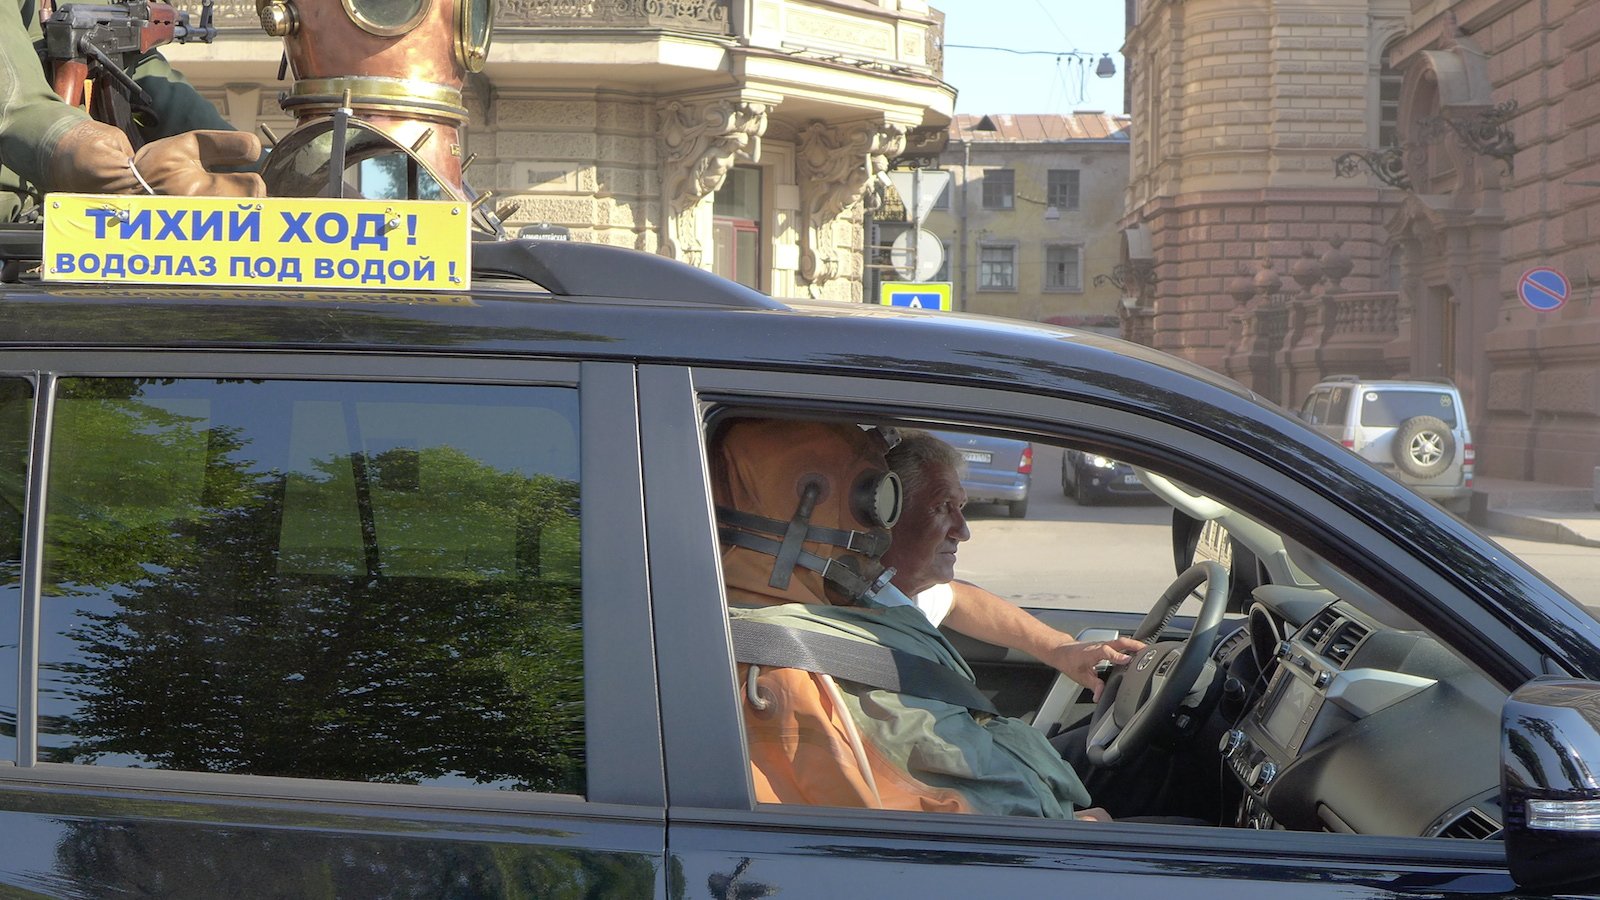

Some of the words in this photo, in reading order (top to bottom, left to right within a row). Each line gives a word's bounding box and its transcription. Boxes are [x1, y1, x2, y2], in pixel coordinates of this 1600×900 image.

[85, 203, 261, 242] ТИХИЙ
[278, 211, 389, 251] ХОД
[56, 253, 217, 278] ВОДОЛАЗ
[230, 256, 302, 282] ПОД
[314, 255, 435, 285] ВОДОЙ
